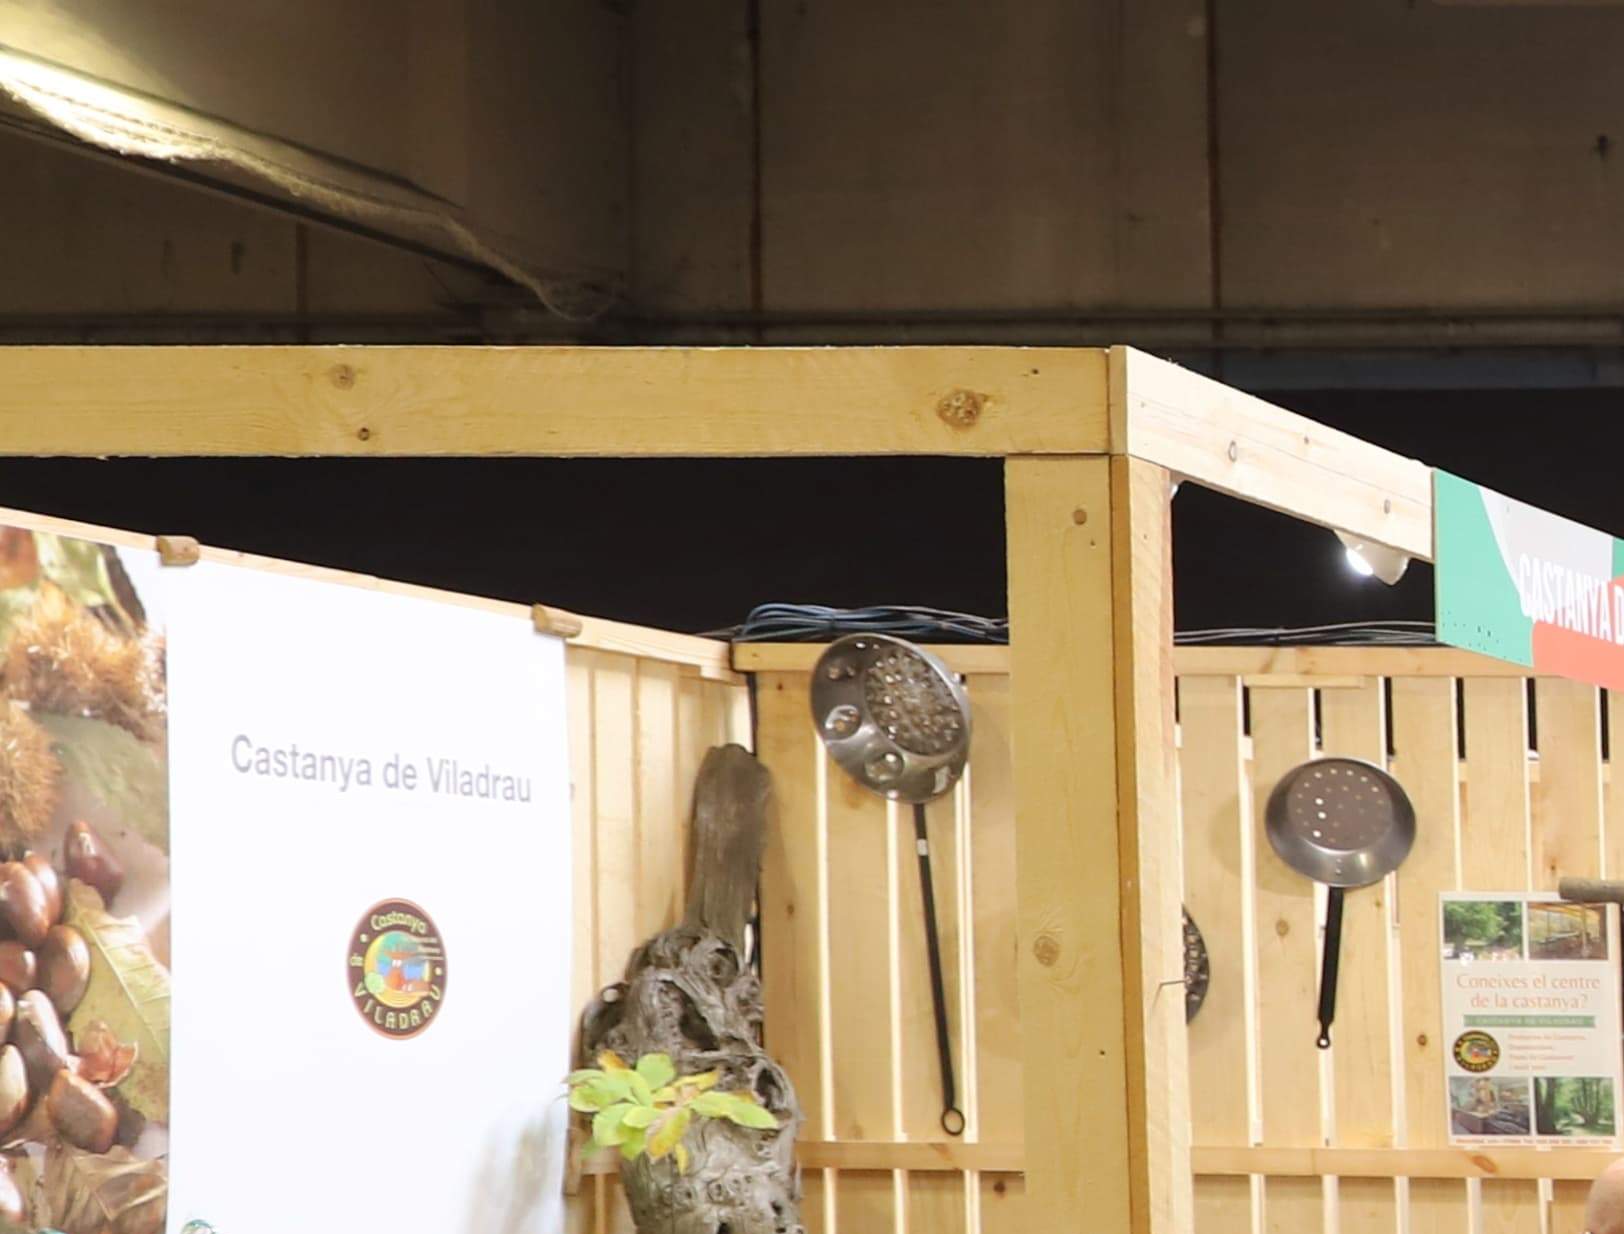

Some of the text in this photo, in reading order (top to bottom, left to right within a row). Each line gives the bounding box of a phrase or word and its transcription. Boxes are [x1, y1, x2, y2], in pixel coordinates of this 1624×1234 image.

[1519, 552, 1613, 643] CASTANYA
[231, 734, 532, 803] Castanya de Viladrau
[354, 982, 441, 1029] VILADRAU
